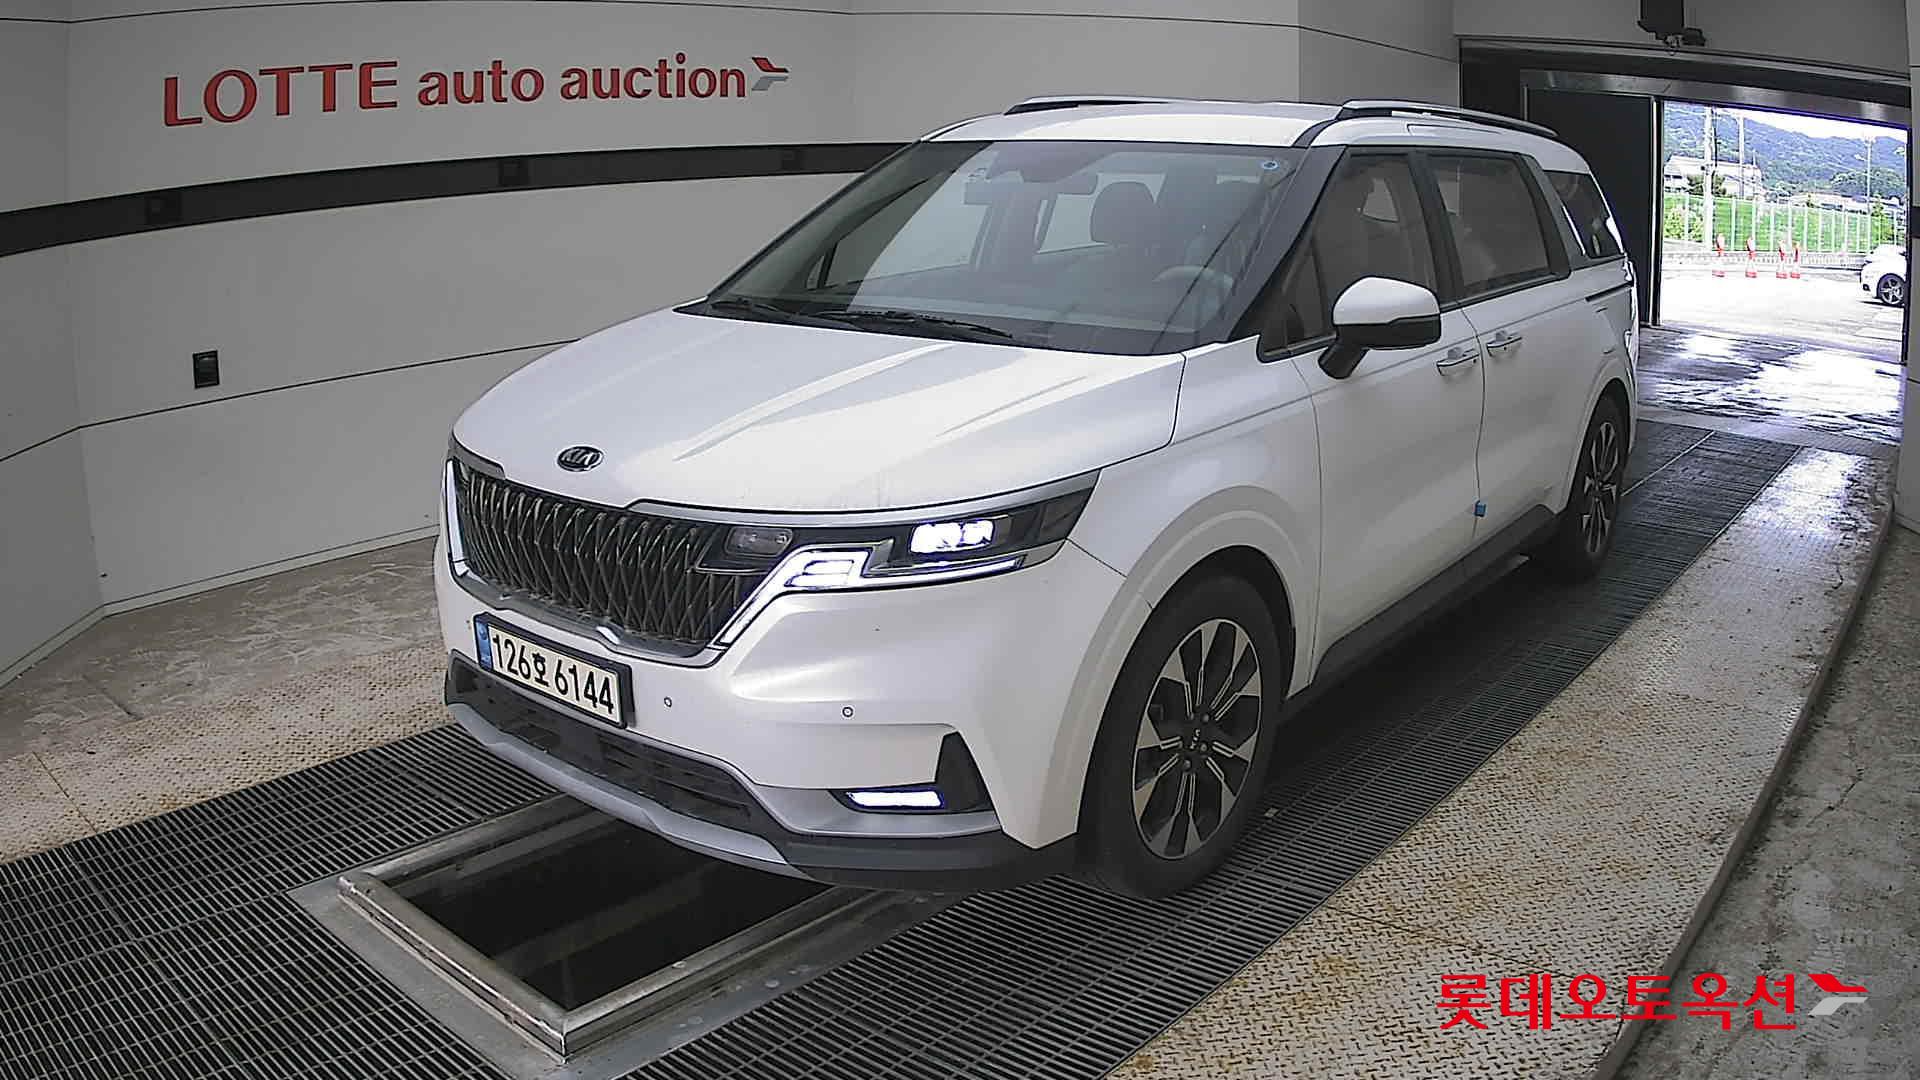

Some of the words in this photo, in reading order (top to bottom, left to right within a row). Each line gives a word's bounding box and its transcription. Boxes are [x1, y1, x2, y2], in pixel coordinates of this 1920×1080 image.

[163, 60, 399, 127] LOTTE
[417, 59, 545, 106] auto
[560, 52, 747, 100] auction
[560, 448, 600, 467] KIA
